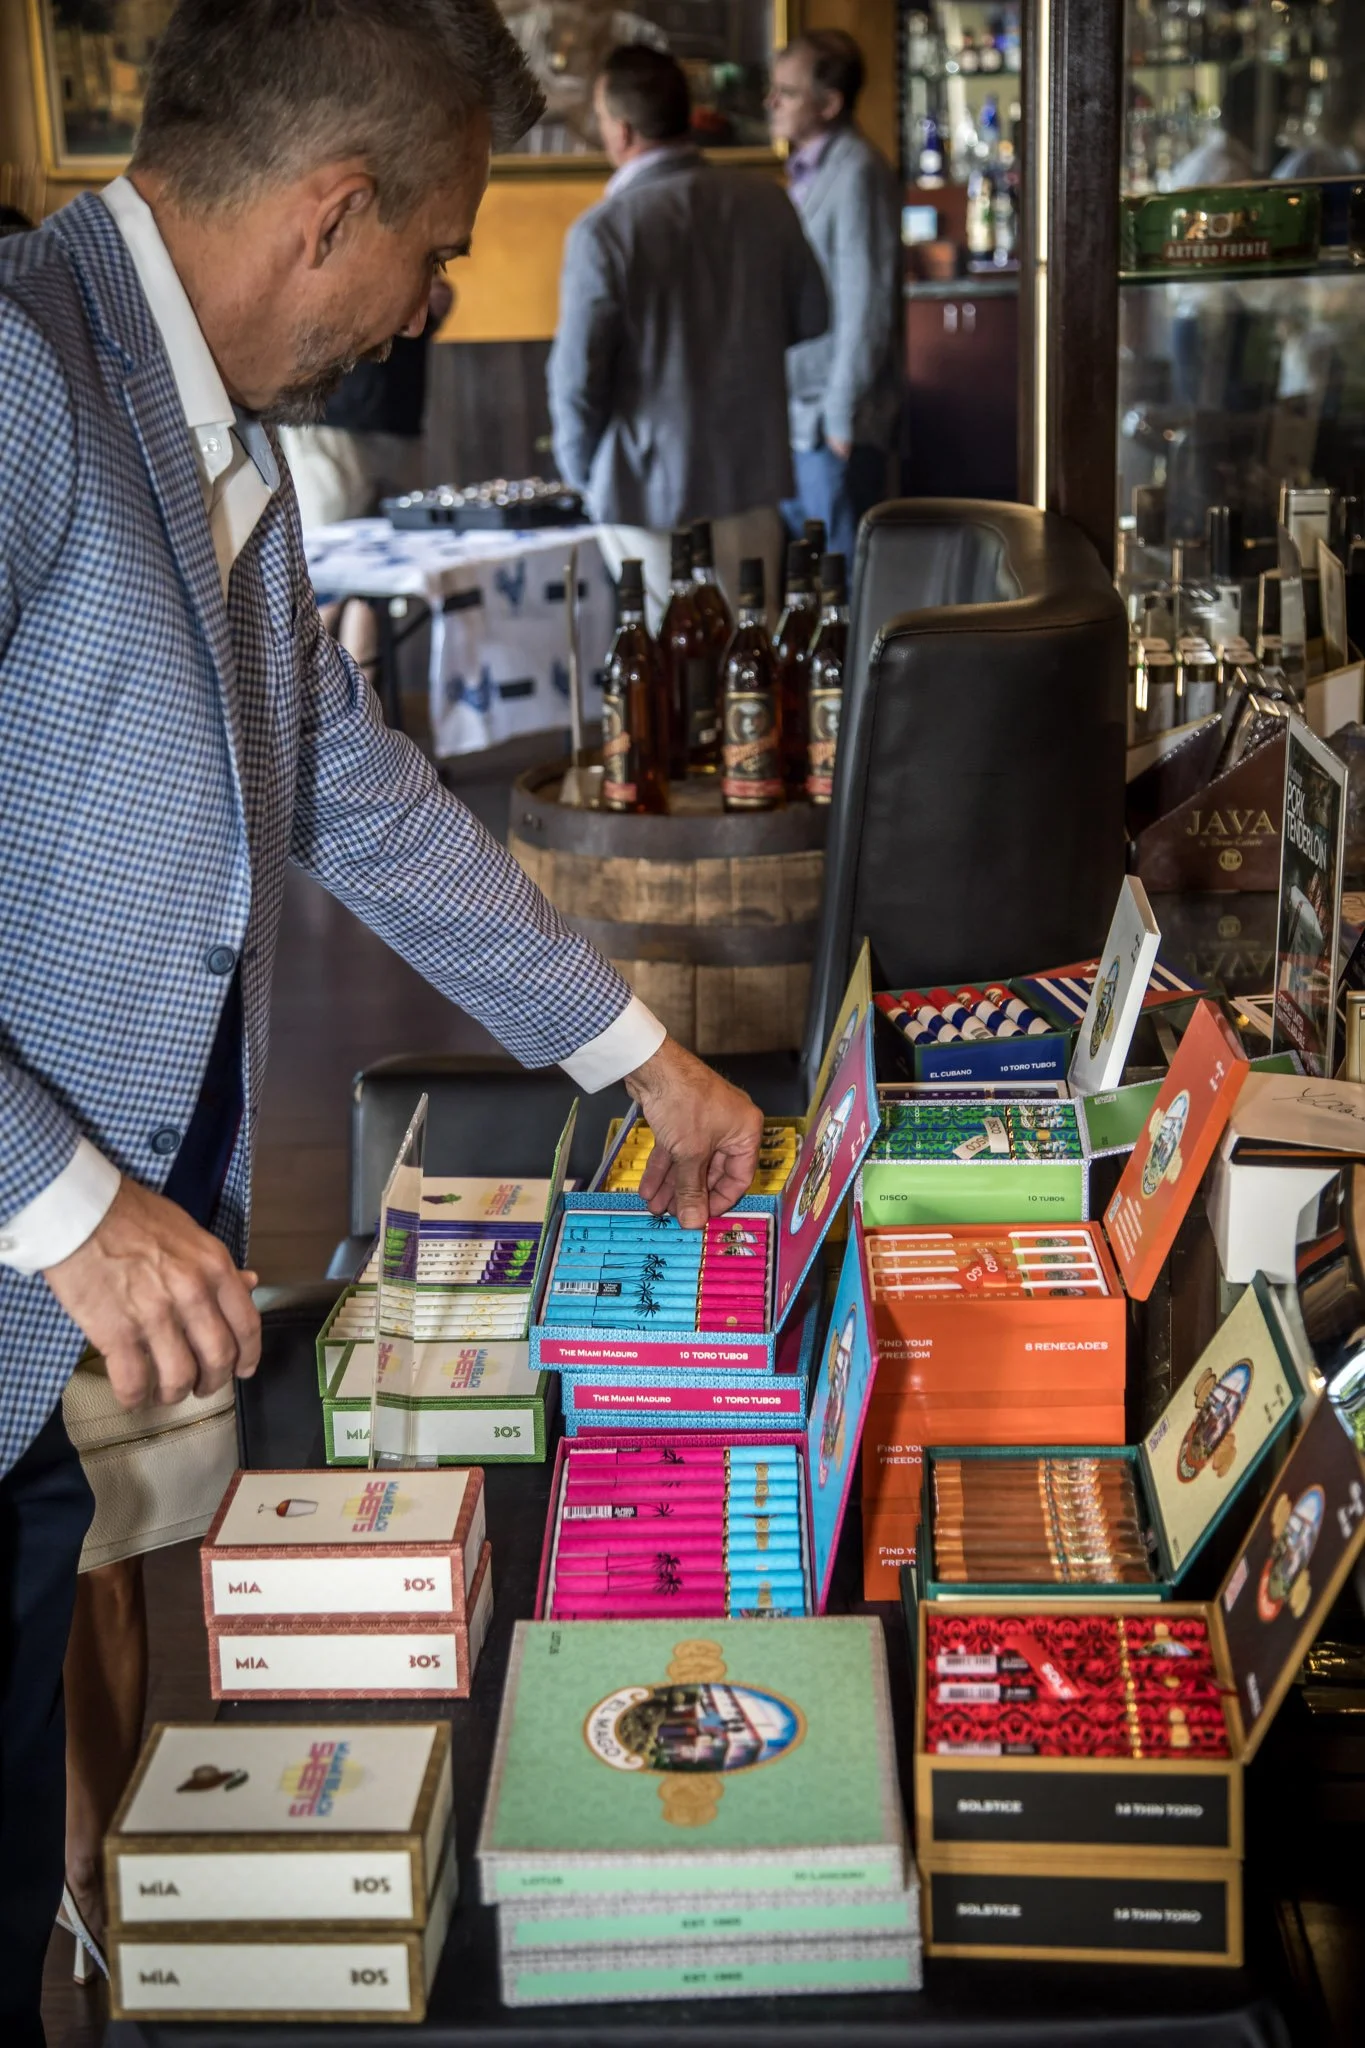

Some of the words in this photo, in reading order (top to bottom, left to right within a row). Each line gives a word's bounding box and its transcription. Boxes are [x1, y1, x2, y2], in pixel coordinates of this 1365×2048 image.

[1167, 244, 1219, 259] ARTURO
[1221, 241, 1269, 258] FUENTE
[1287, 780, 1306, 822] PORK
[1185, 809, 1279, 836] JAVA
[929, 1071, 940, 1079] EL
[941, 1069, 973, 1078] CUBANO
[1010, 1063, 1031, 1072] TORO
[1032, 1061, 1057, 1070] TUBOS
[904, 1339, 933, 1347] YOUR
[1024, 1342, 1034, 1351] 8
[1035, 1341, 1108, 1351] RENEGADES
[559, 1348, 576, 1357] THE
[577, 1348, 602, 1358] MIAMI
[602, 1349, 639, 1359] MADURO
[679, 1351, 690, 1360] 10
[692, 1351, 718, 1361] TORO
[718, 1351, 749, 1361] TUBOS
[879, 1351, 931, 1359] FREEDOM
[592, 1394, 609, 1402] THE
[610, 1394, 635, 1403] MIAMI
[635, 1395, 671, 1403] MADURO
[712, 1395, 723, 1404] 10
[725, 1396, 750, 1405] TORO
[750, 1396, 781, 1405] TUBOS
[346, 1429, 371, 1440] MIA
[493, 1426, 521, 1438] 305
[880, 1457, 922, 1465] FREEDO
[878, 1546, 905, 1555] FIND
[228, 1582, 263, 1595] MIA
[403, 1577, 436, 1592] 305
[235, 1656, 270, 1670] MIA
[408, 1654, 441, 1669] 305
[957, 1798, 1023, 1814] SOLSTICE
[1132, 1803, 1165, 1818] THIN
[1165, 1804, 1204, 1818] TORO
[138, 1880, 181, 1897] MIA
[352, 1876, 392, 1895] 305
[956, 1902, 1022, 1918] SOLSTICE
[1131, 1907, 1163, 1922] THIN
[1164, 1909, 1202, 1923] TORO
[138, 1968, 181, 1986] MIA
[349, 1967, 390, 1986] 305
